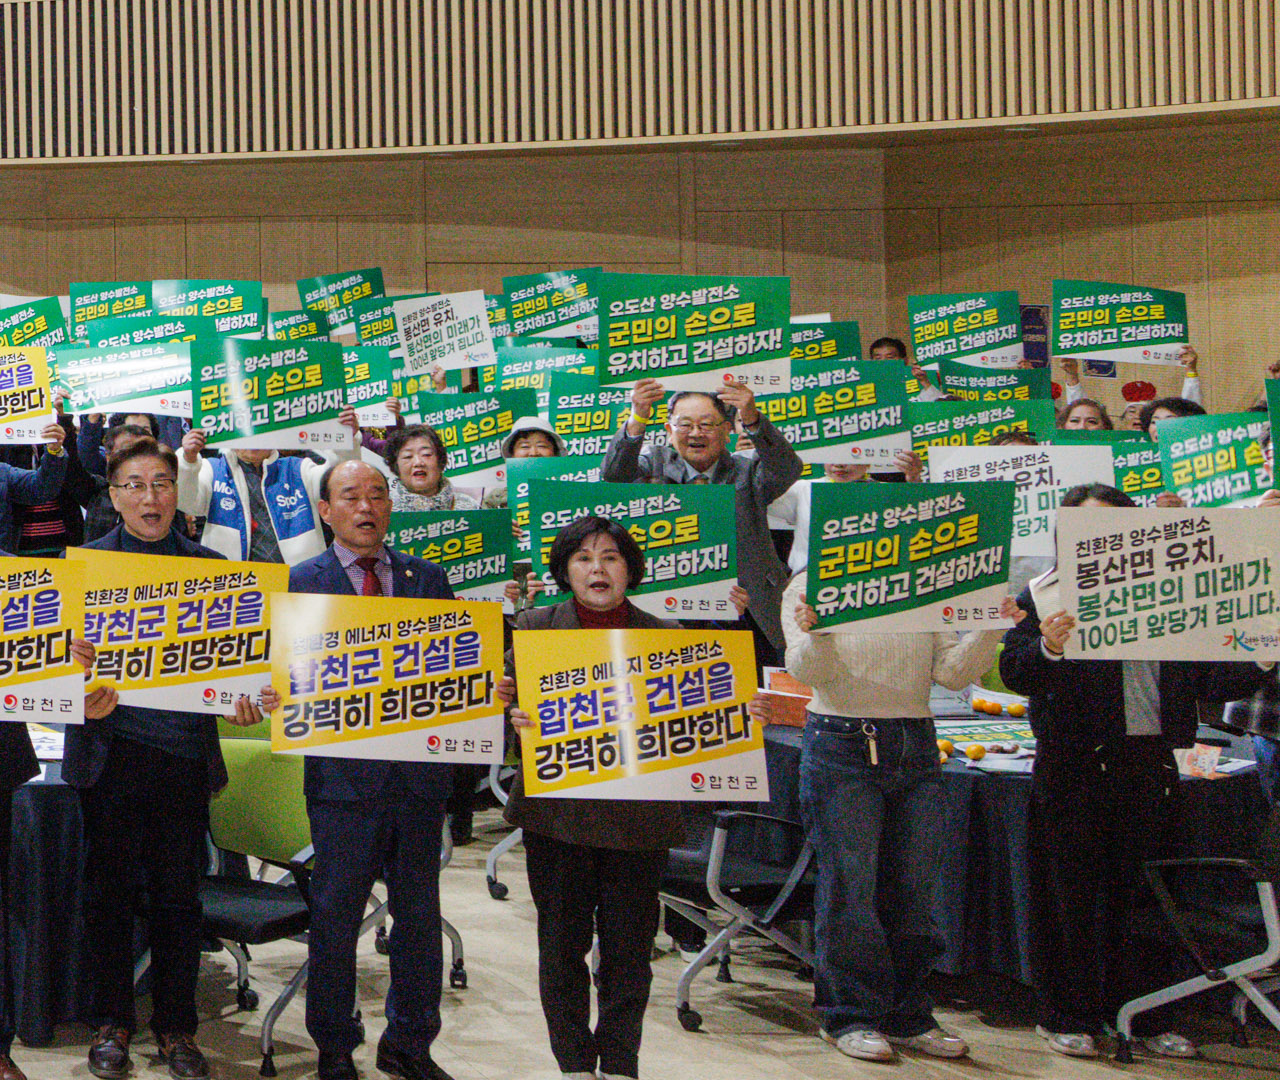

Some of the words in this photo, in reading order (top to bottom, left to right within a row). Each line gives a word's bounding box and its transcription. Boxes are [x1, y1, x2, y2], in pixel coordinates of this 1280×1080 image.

[609, 296, 656, 317] 오도산
[660, 284, 740, 311] 양수발전소
[1059, 310, 1109, 329] 군민의
[1115, 305, 1165, 323] 손으로
[1061, 296, 1095, 309] 오도산
[1098, 292, 1154, 306] 양수발전소
[404, 317, 430, 341] 봉산면
[434, 308, 458, 327] 유치,
[407, 329, 443, 357] 봉산면의
[446, 315, 480, 339] 미래가
[608, 315, 676, 347] 군민의
[685, 302, 756, 337] 손으로
[1058, 329, 1118, 349] 유치하고
[1121, 324, 1184, 343] 건설하자!
[200, 360, 240, 382] 오도산
[245, 347, 308, 371] 양수발전소
[410, 353, 428, 371] 100년
[430, 342, 455, 361] 앞당겨
[608, 344, 688, 376] 유치하고
[693, 328, 782, 364] 건설하자!
[200, 376, 259, 411] 군민의
[266, 364, 323, 397] 손으로
[200, 404, 269, 437] 유치하고
[273, 388, 343, 422] 건설하자!
[822, 511, 878, 540] 오도산
[883, 492, 966, 528] 양수발전소
[1076, 533, 1123, 558] 친환경
[1130, 516, 1210, 547] 양수발전소
[819, 534, 900, 580] 군민의
[909, 514, 979, 562] 손으로
[1076, 549, 1154, 589] 봉산면
[1165, 536, 1223, 572] 유치,
[815, 572, 910, 617] 유치하고
[916, 545, 1003, 596] 건설하자!
[1078, 576, 1183, 622] 봉산면의
[1195, 558, 1270, 598] 미래가
[1078, 618, 1138, 651] 100년
[1147, 604, 1207, 639] 앞당겨
[1216, 591, 1280, 625] 집니다.
[540, 667, 586, 693] 친환경
[648, 640, 723, 670] 양수발전소
[537, 683, 632, 737] 합천군
[646, 662, 733, 714] 건설을
[535, 729, 627, 782] 강력히
[637, 702, 749, 760] 희망한다
[709, 775, 757, 790] 합천군
